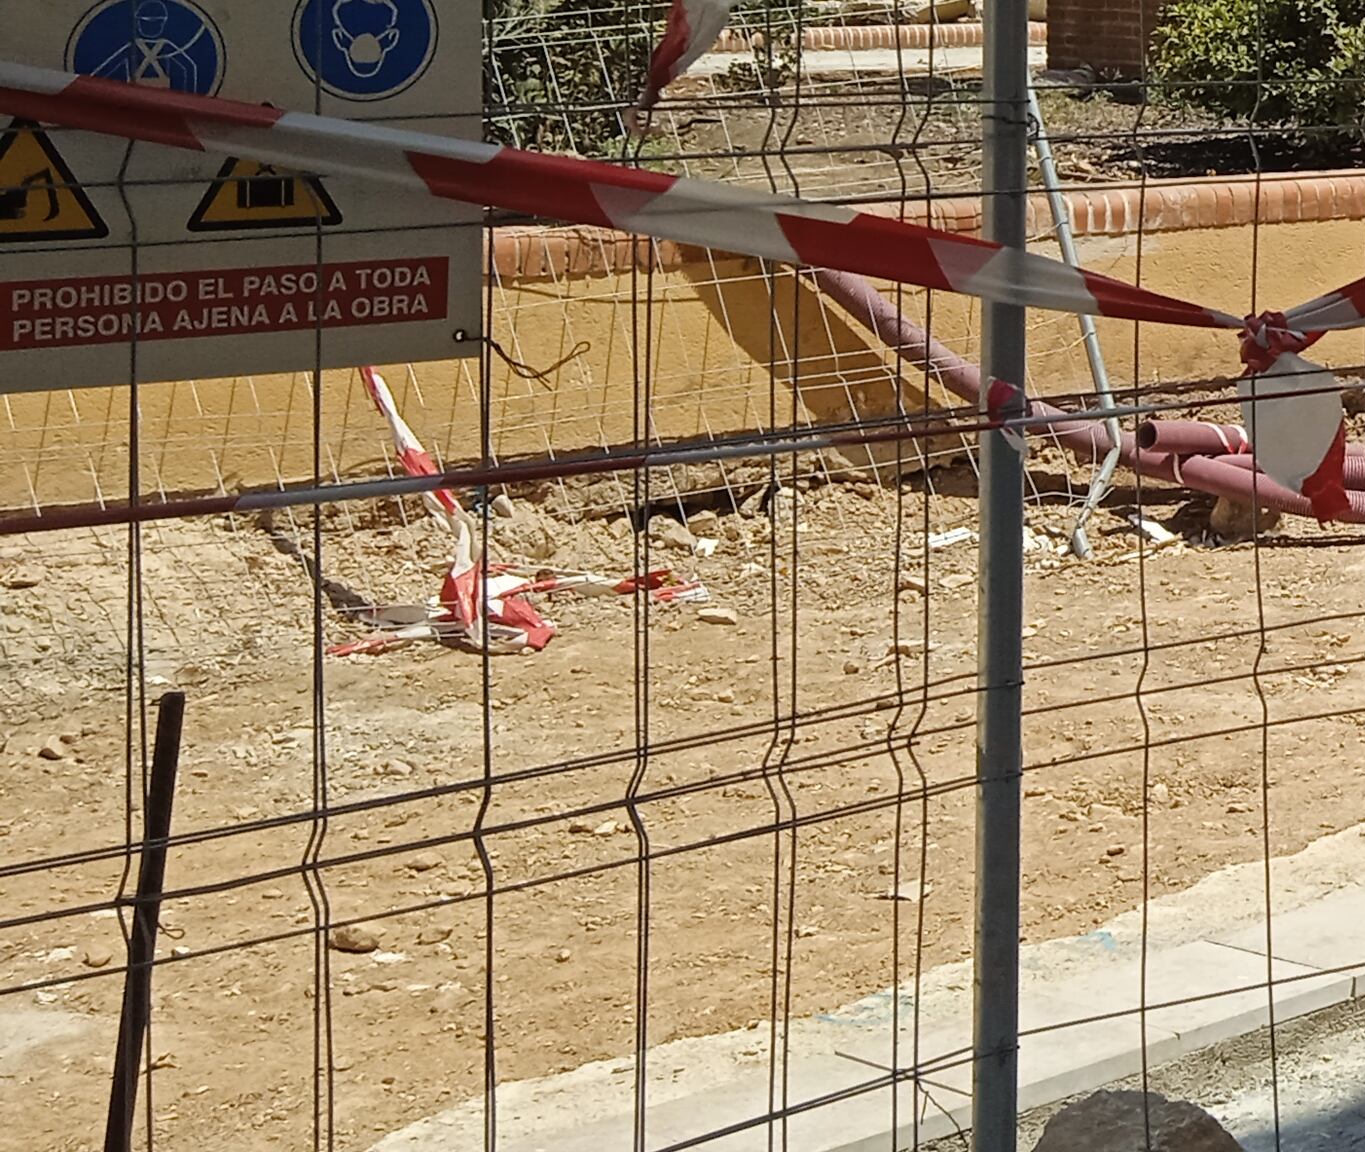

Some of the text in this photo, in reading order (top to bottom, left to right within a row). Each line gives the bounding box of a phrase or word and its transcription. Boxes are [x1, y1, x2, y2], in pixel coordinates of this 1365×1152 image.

[12, 265, 431, 312] PROHIBIDO EL PASO A TODA
[13, 294, 429, 342] PERSONA AJENA A LA OBRA
